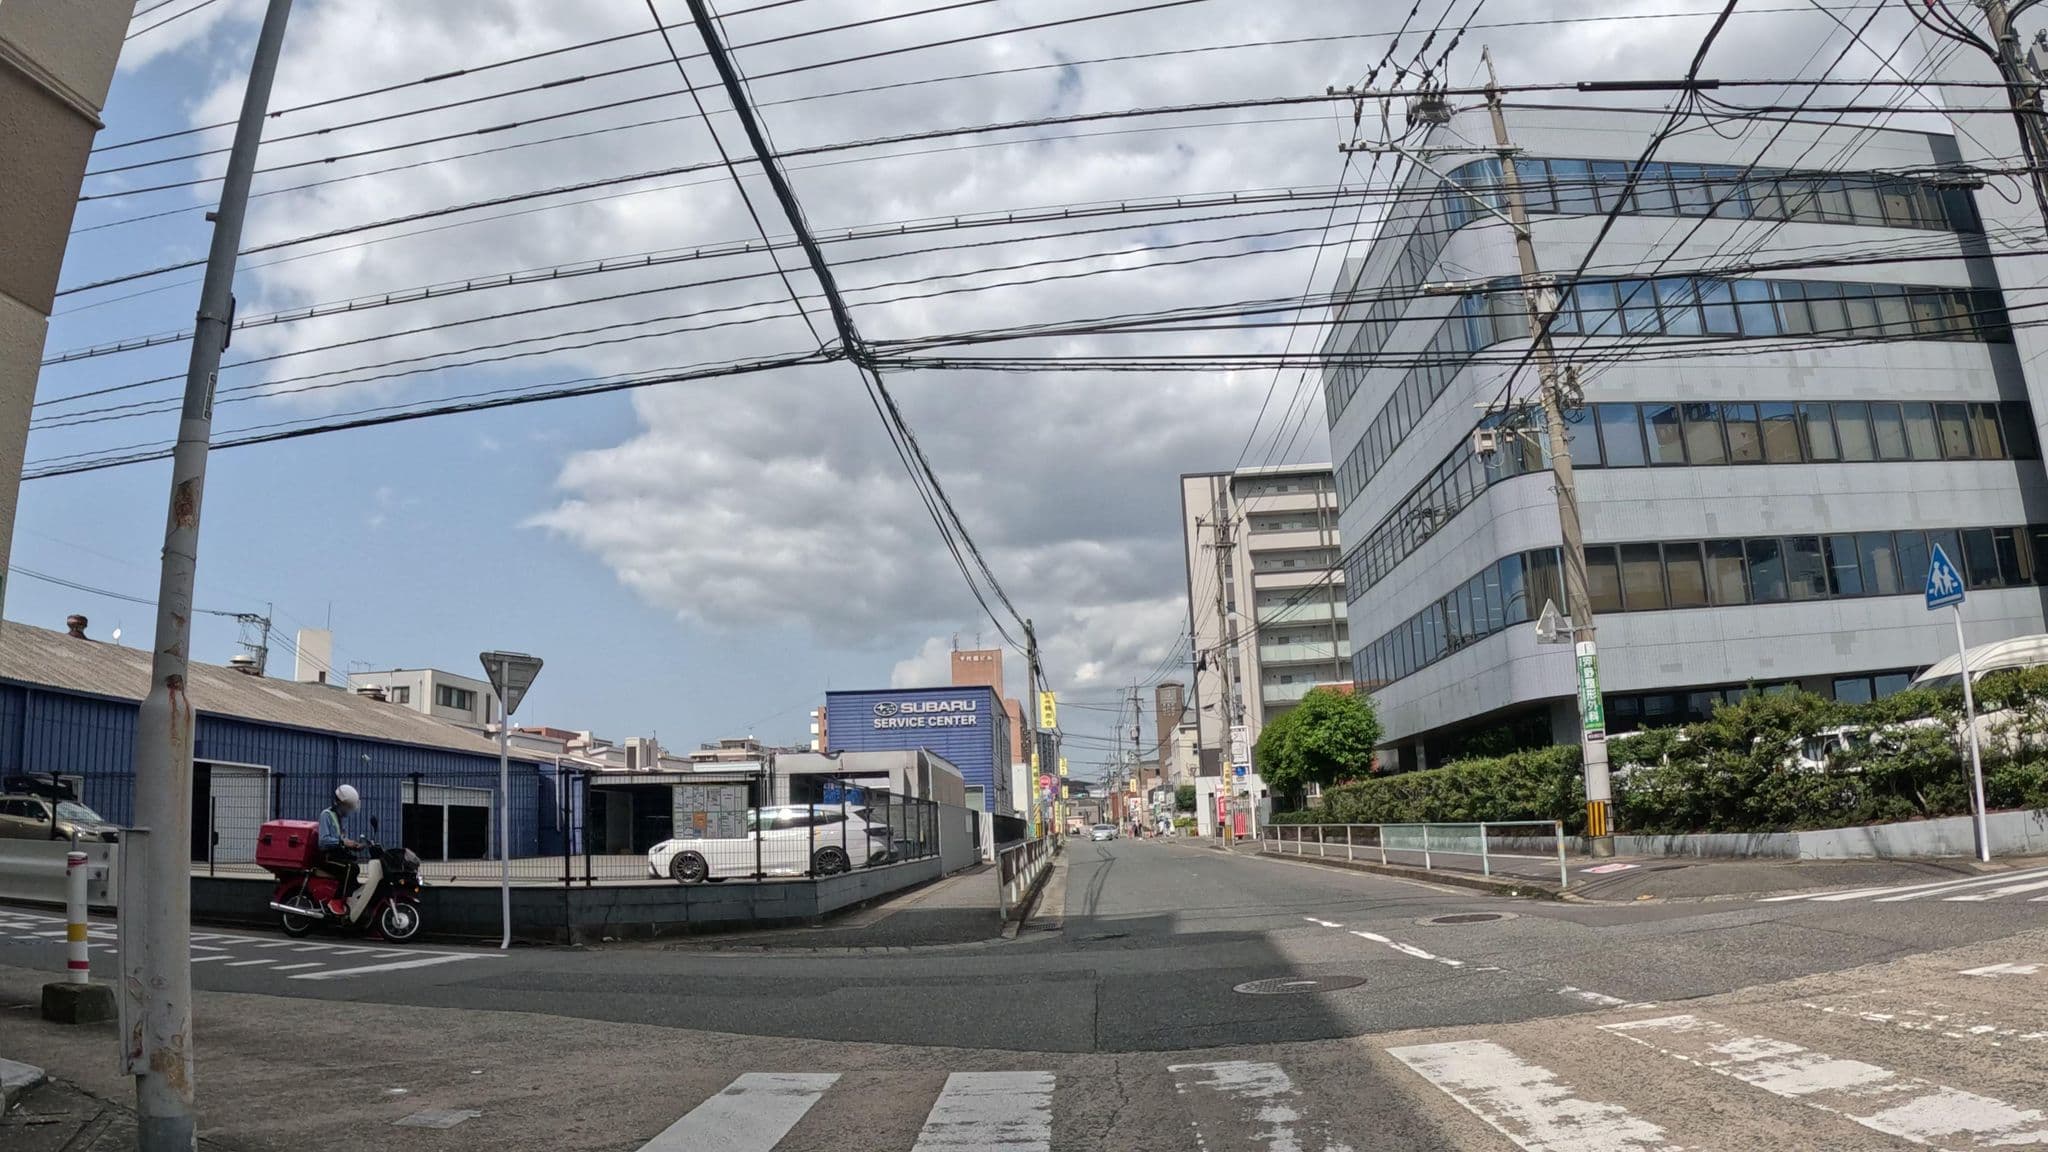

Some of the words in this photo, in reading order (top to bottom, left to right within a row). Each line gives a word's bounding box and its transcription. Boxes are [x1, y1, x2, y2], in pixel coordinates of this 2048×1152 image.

[900, 700, 977, 713] SUBARU
[873, 717, 925, 729] SERVICE
[928, 715, 977, 727] CENTER
